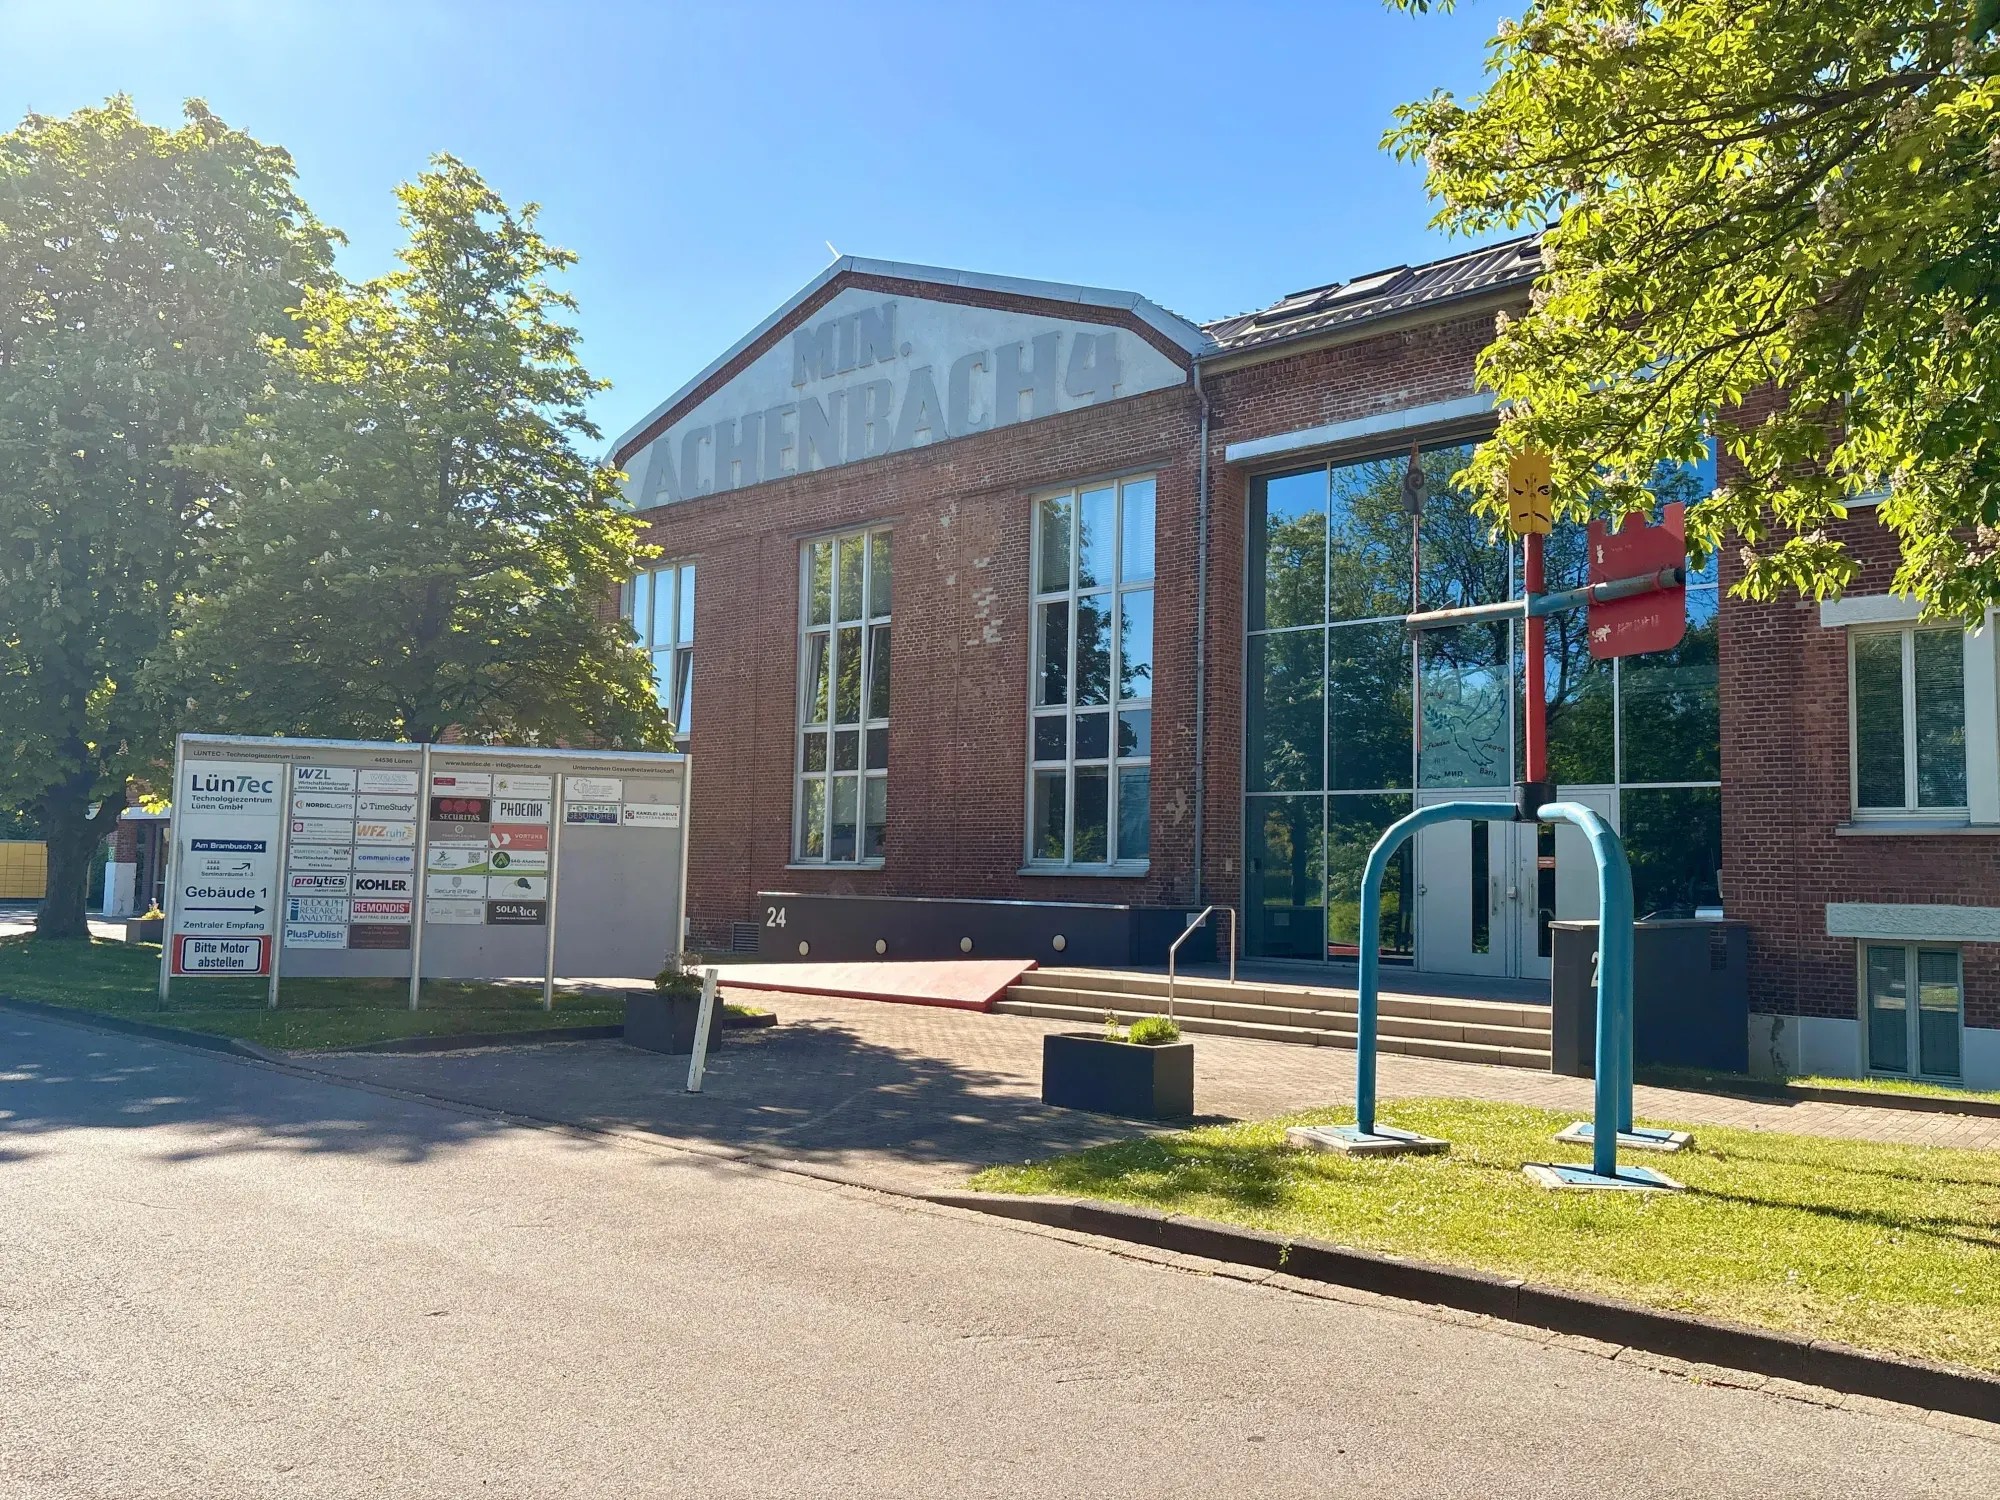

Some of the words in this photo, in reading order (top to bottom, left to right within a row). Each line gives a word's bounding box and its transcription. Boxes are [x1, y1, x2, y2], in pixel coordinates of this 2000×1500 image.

[792, 299, 912, 388] MIN.
[1481, 743, 1506, 753] peace
[226, 751, 290, 759] Technologiezentrum
[445, 760, 491, 768] www.luentec.de
[495, 761, 542, 769] info@luentec.de
[572, 764, 611, 772] Unternehmen
[611, 765, 675, 774] Gesundheitswirtschaft
[298, 768, 331, 780] WZL
[191, 773, 274, 794] LünTec
[191, 795, 273, 804] Technologiezentrum
[191, 802, 216, 810] Lünen
[218, 803, 244, 811] GmbH
[368, 802, 413, 812] TimeStudy
[500, 802, 543, 817] PHOENIX
[439, 813, 481, 822] SECURITAS
[567, 812, 617, 820] GESUNDHEIT
[194, 841, 209, 849] Am
[210, 842, 252, 850] Brambusch
[293, 876, 345, 888] prolytics
[185, 885, 256, 898] Gebäude
[260, 887, 267, 899] 1
[300, 899, 344, 907] RUDOLPH
[299, 914, 344, 923] ANALYTICAL
[766, 906, 787, 928] 24
[183, 921, 224, 929] Zentraler
[226, 921, 265, 931] Empfang
[286, 929, 343, 939] PlusPublish
[194, 941, 217, 953] Bitte
[220, 942, 250, 954] Motor
[197, 956, 245, 968] abstellen
